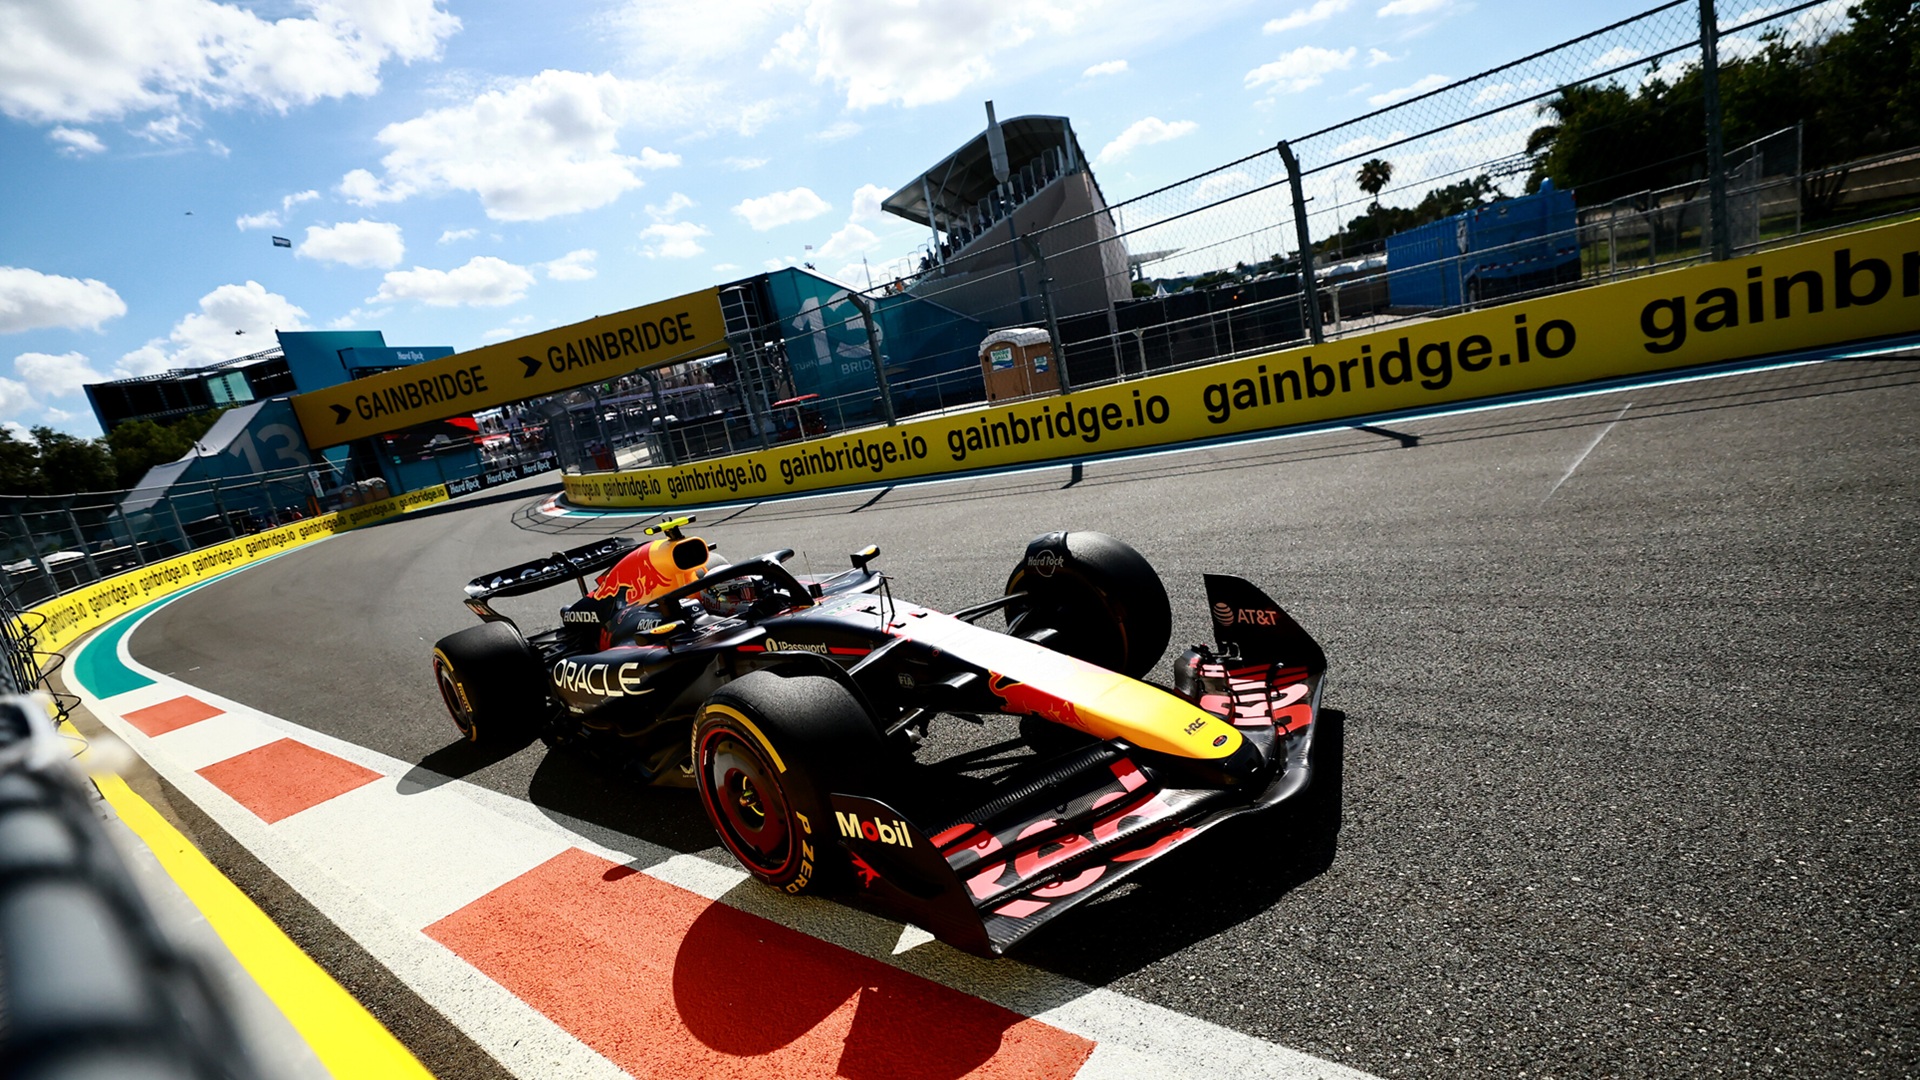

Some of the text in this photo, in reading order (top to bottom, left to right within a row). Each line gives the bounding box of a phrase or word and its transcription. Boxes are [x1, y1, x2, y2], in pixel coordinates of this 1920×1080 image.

[791, 289, 884, 366] 13
[547, 312, 696, 374] GAINBRIDGE
[841, 354, 890, 376] BRIDE
[1202, 313, 1578, 424] gainbridge.io
[355, 364, 489, 421] GAINBRIDGE
[946, 389, 1171, 461] gainbridge.io
[228, 423, 311, 484] 13
[779, 430, 928, 486] gainbridge.io
[449, 477, 481, 494] Hard Rock
[486, 468, 518, 485] Hard Rock
[602, 474, 662, 502] gainbridge.io
[667, 458, 767, 499] gainbridge.io
[350, 501, 396, 524] gainbridge.io
[399, 489, 445, 510] gainbridge.io
[299, 516, 346, 540] gainbridge.io
[245, 530, 296, 557] gainbridge.io
[192, 544, 243, 576] gainbridge.io
[1028, 555, 1046, 567] Hard
[564, 611, 600, 623] HONDA
[1238, 608, 1277, 626] AT&T
[553, 658, 655, 697] ORACLE
[1184, 717, 1206, 736] HRC
[834, 811, 914, 848] Mobil
[785, 811, 815, 894] P ZERO
